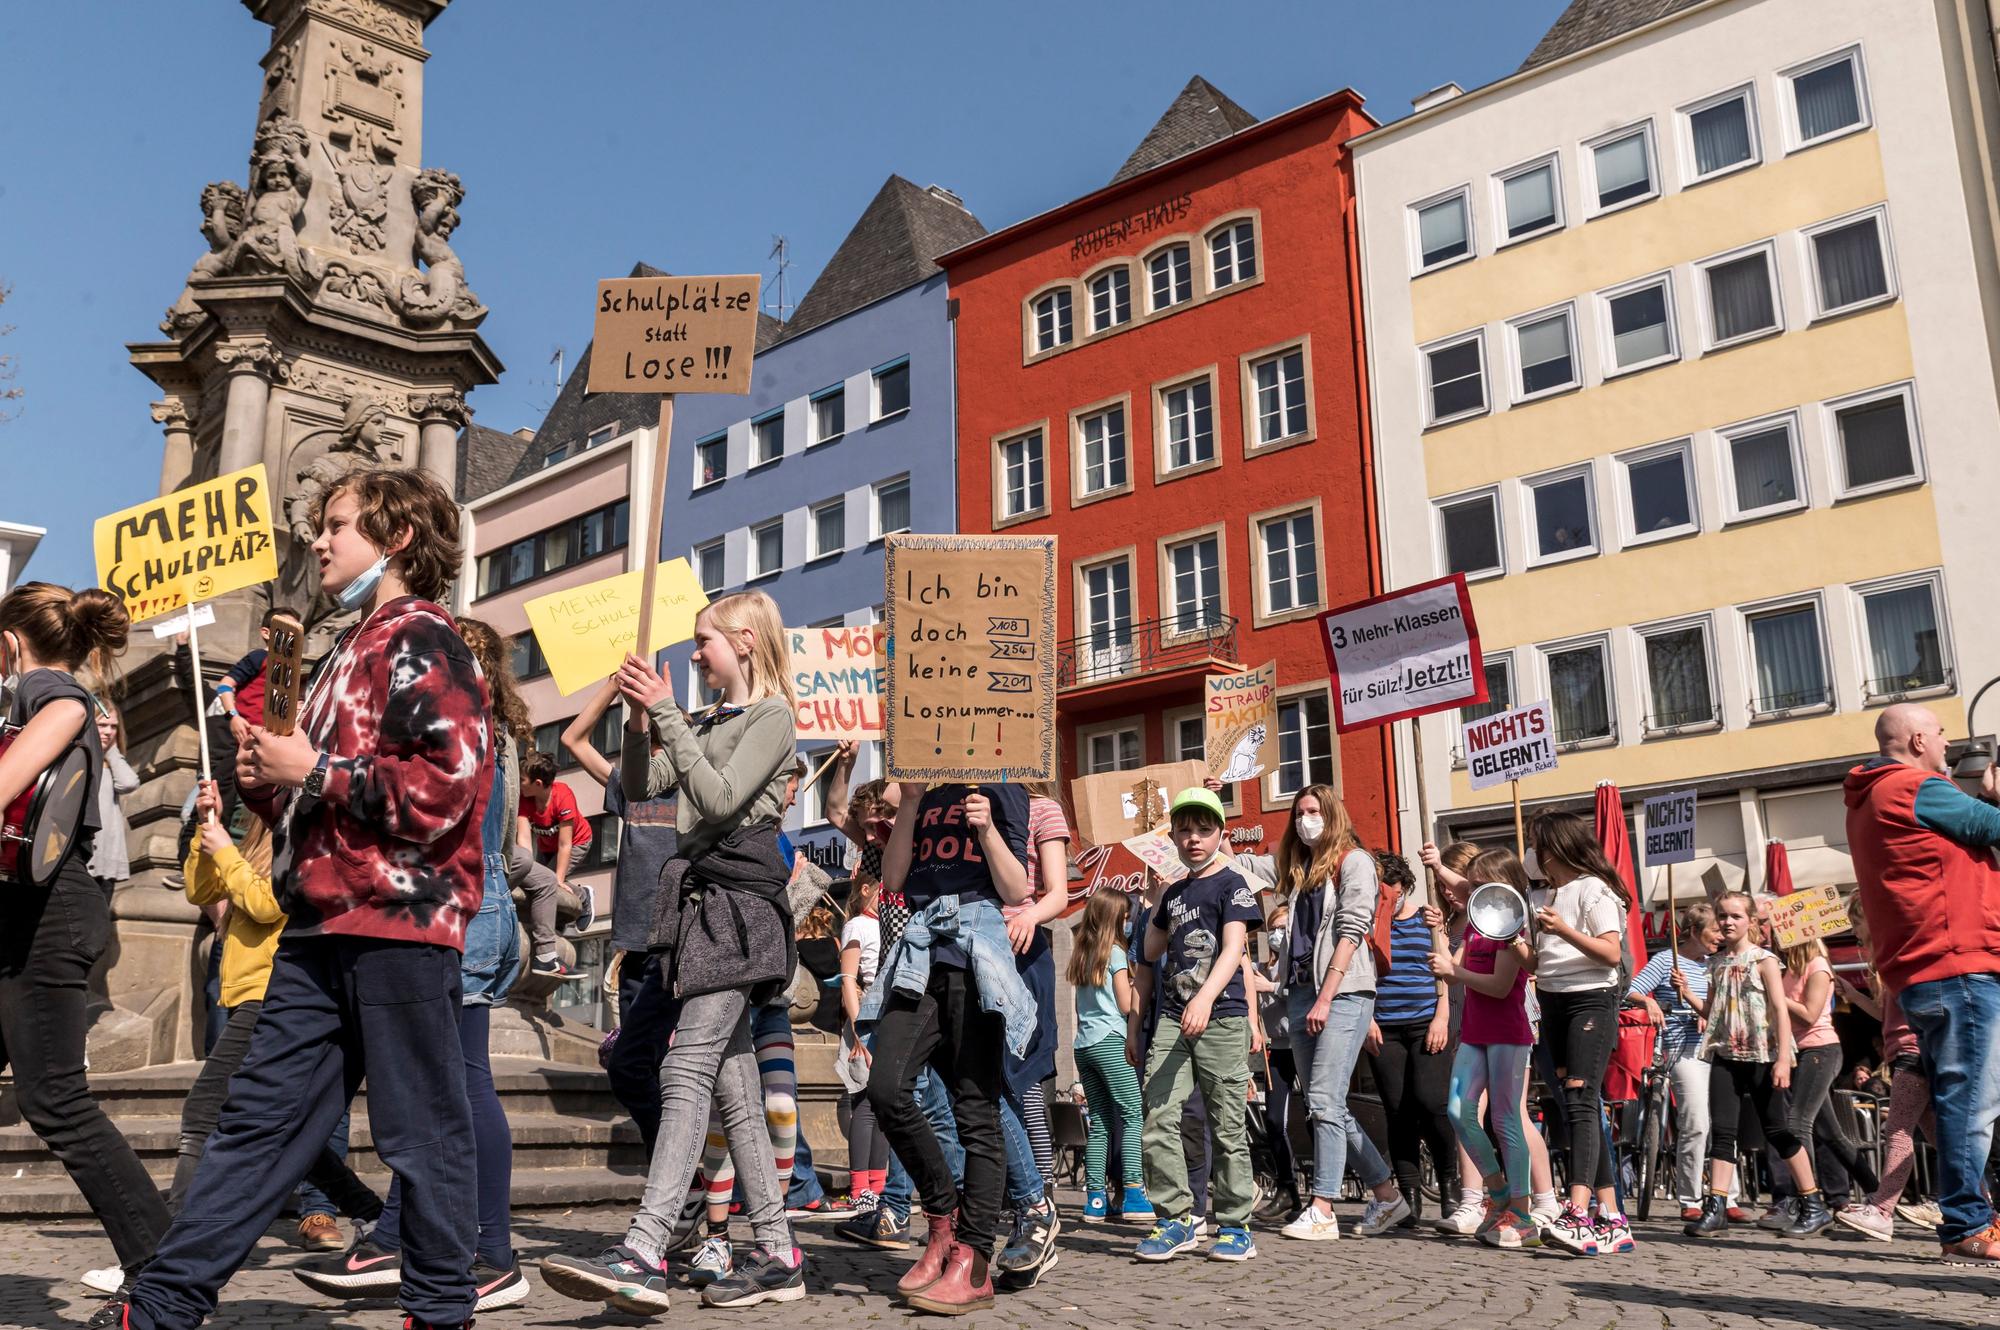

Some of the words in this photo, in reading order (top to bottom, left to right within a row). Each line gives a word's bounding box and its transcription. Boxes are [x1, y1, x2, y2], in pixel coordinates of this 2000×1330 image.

[1075, 192, 1192, 250] RODEN-HAUS
[600, 282, 751, 320] Schulplätze
[645, 322, 688, 342] statt
[115, 477, 260, 564] MEHR
[908, 570, 950, 604] Ich
[977, 572, 1018, 598] bin
[549, 587, 621, 624] MEHR
[608, 632, 639, 648] KÖL
[911, 618, 967, 642] doch
[996, 621, 1018, 632] 108
[1331, 626, 1348, 649] 3
[1352, 605, 1460, 645] Mehr-Klassen
[1003, 644, 1028, 656] 254
[796, 667, 886, 697] SAMME
[909, 654, 978, 679] keine
[1002, 676, 1027, 689] 201
[1208, 669, 1273, 691] VOGEL-
[1343, 687, 1363, 705] für
[1367, 676, 1403, 699] Sülz!
[1405, 654, 1471, 692] Jetzt!!
[1467, 708, 1545, 753] NICHTS
[1472, 738, 1549, 778] GELERNT!
[1646, 796, 1694, 829] NICHTS
[1646, 827, 1693, 856] GELERNT!
